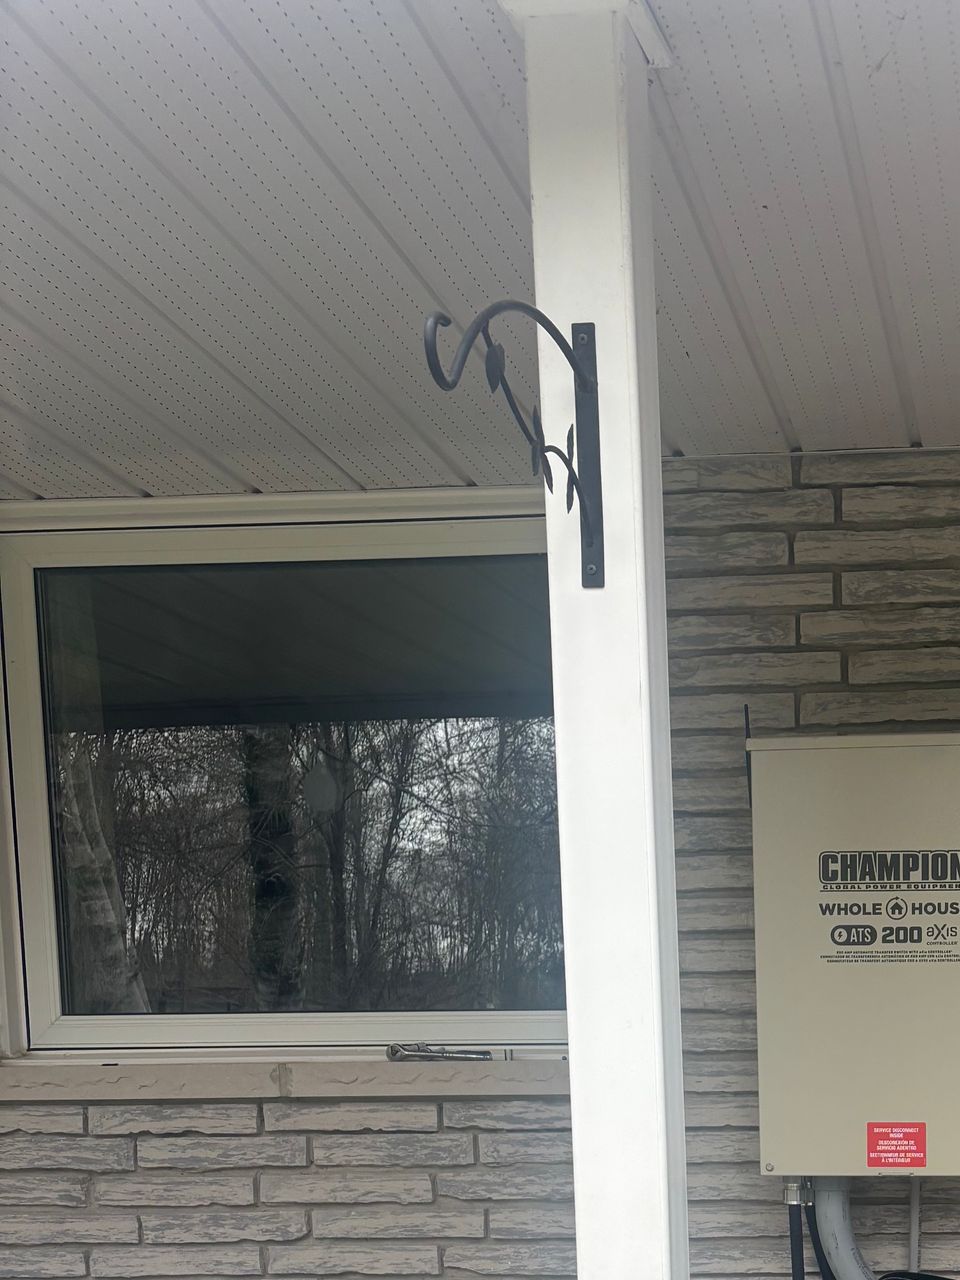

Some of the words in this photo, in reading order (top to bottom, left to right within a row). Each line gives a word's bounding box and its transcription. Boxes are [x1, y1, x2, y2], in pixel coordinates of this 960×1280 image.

[819, 903, 882, 915] WHOLE
[850, 928, 872, 943] ATS
[882, 927, 922, 943] 200
